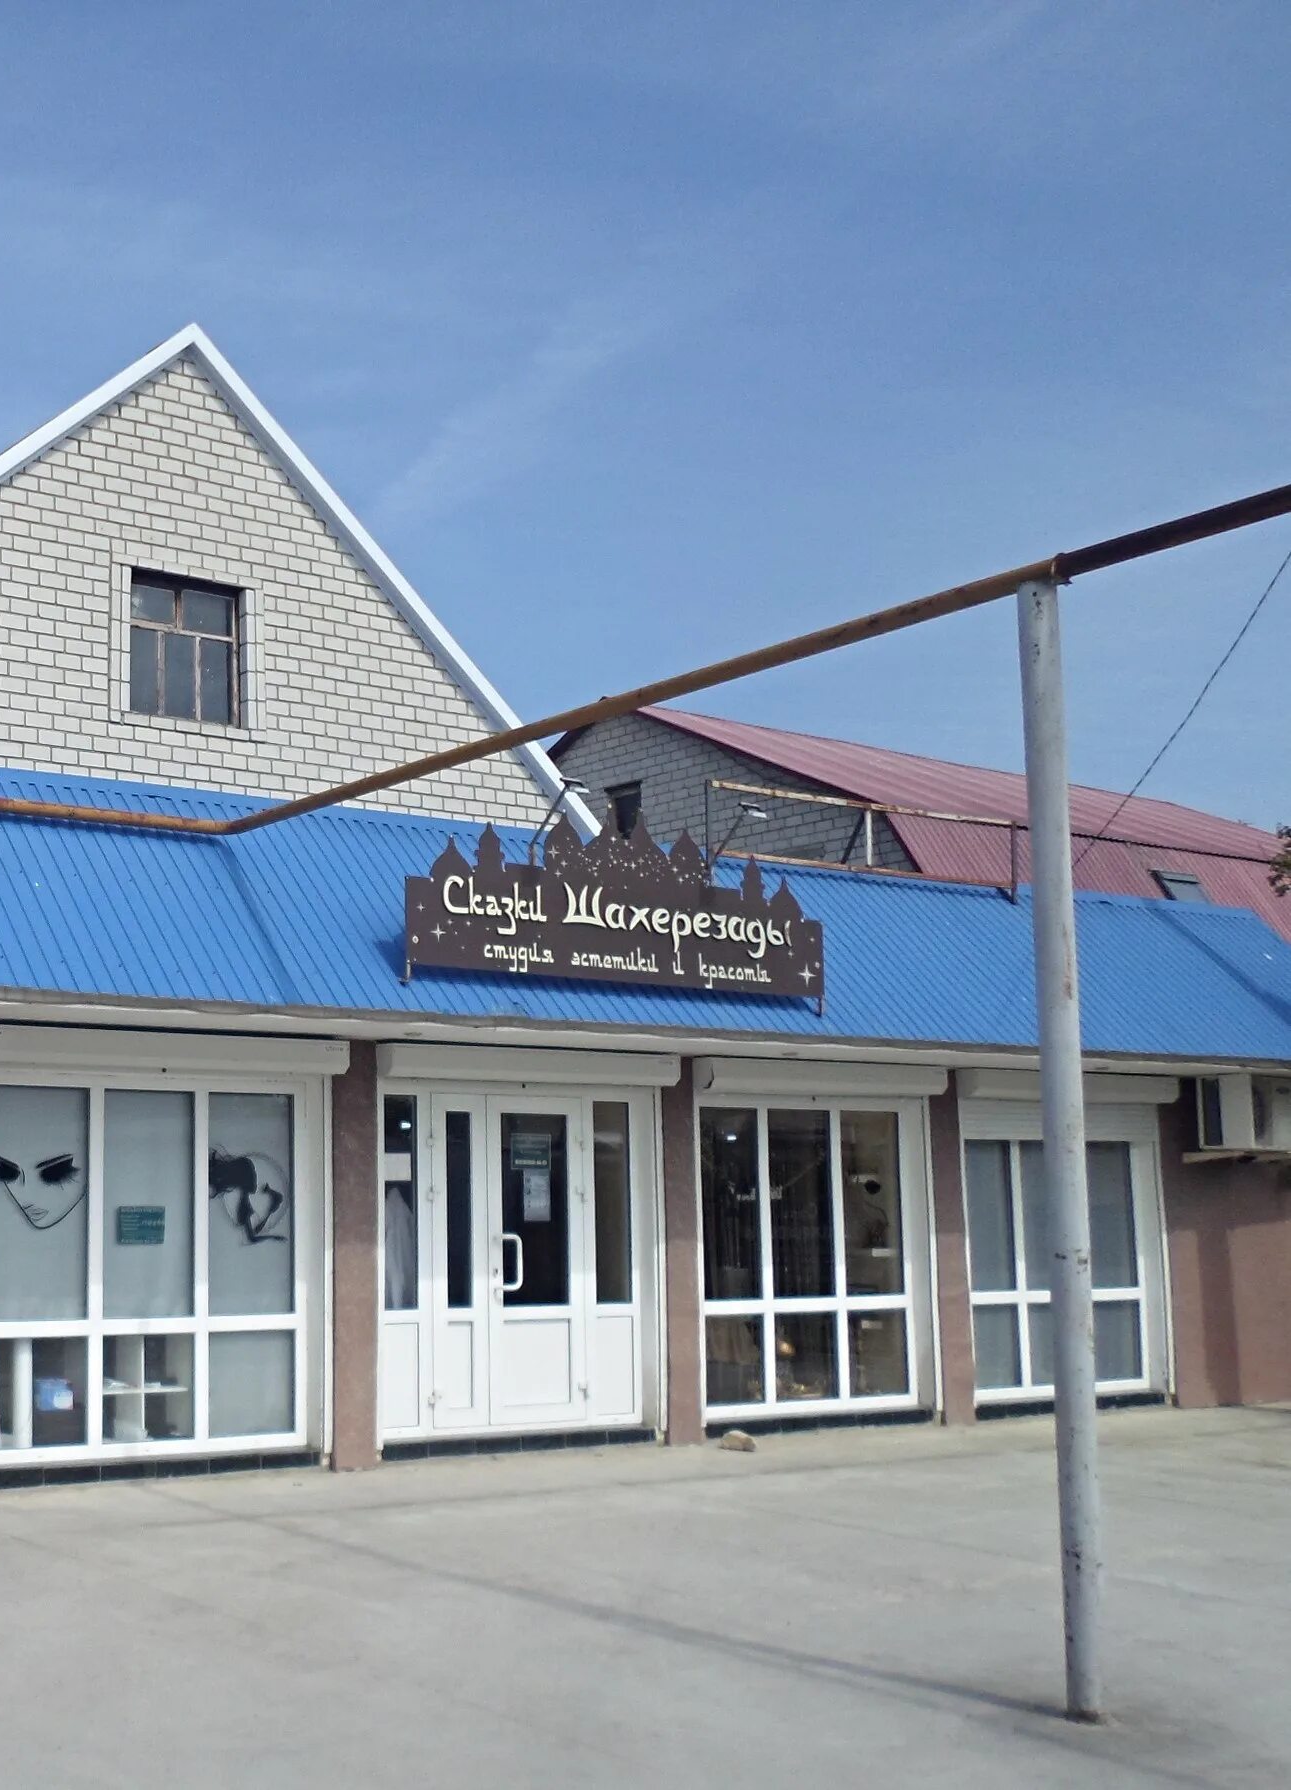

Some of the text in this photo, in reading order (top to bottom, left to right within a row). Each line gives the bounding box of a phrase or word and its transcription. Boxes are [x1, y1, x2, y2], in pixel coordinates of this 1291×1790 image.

[443, 875, 793, 959] Сказки Шахерезады
[484, 942, 771, 989] студия эстетики и красоты
